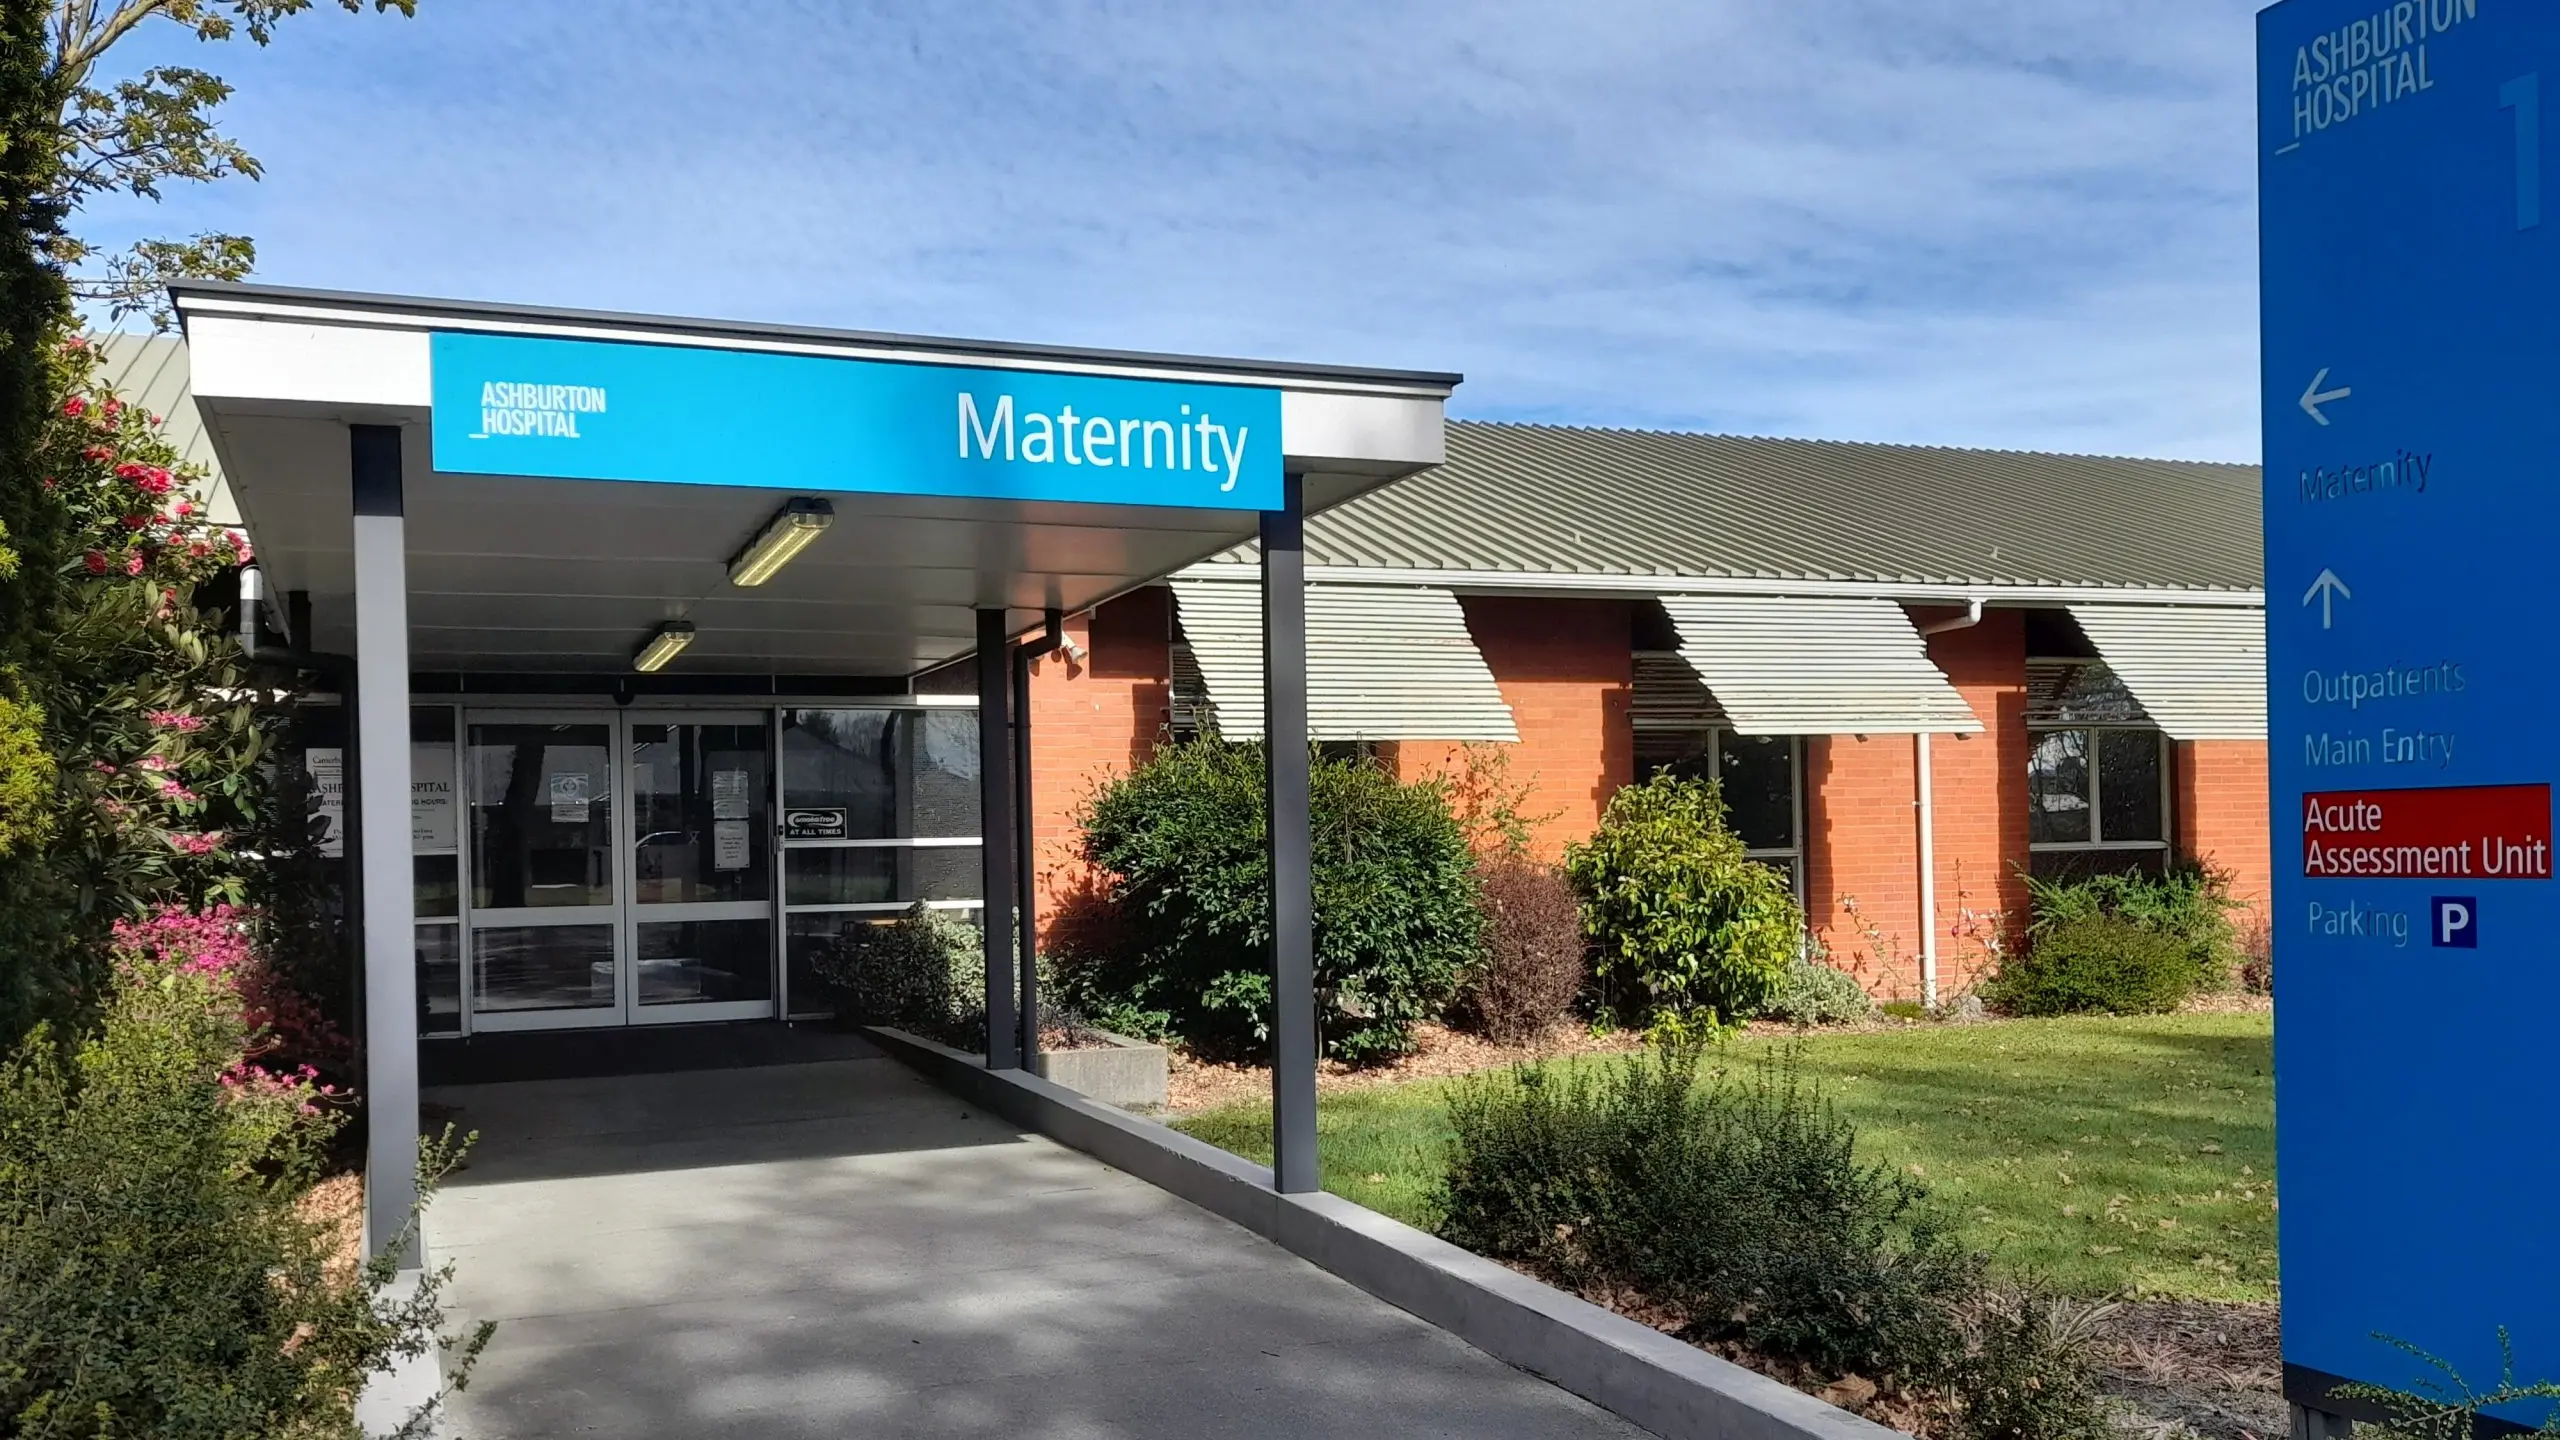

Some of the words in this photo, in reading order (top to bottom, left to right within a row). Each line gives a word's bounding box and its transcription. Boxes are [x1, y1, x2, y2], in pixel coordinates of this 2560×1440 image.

[2293, 45, 2434, 139] HOSPITAL
[2499, 70, 2540, 231] 1
[481, 381, 607, 414] ASHBURTON
[482, 408, 581, 438] HOSPITAL
[957, 392, 1249, 492] Maternity
[2299, 448, 2433, 505] Maternity
[2303, 659, 2467, 710] Outpatients
[2305, 730, 2370, 767] Main
[2383, 727, 2455, 771] Entry
[411, 781, 451, 793] SPITAL
[2304, 797, 2383, 832] Acute
[2305, 838, 2471, 875] Assessment
[2482, 834, 2547, 875] Unit
[2308, 896, 2408, 948] Parking
[2442, 902, 2470, 943] P
